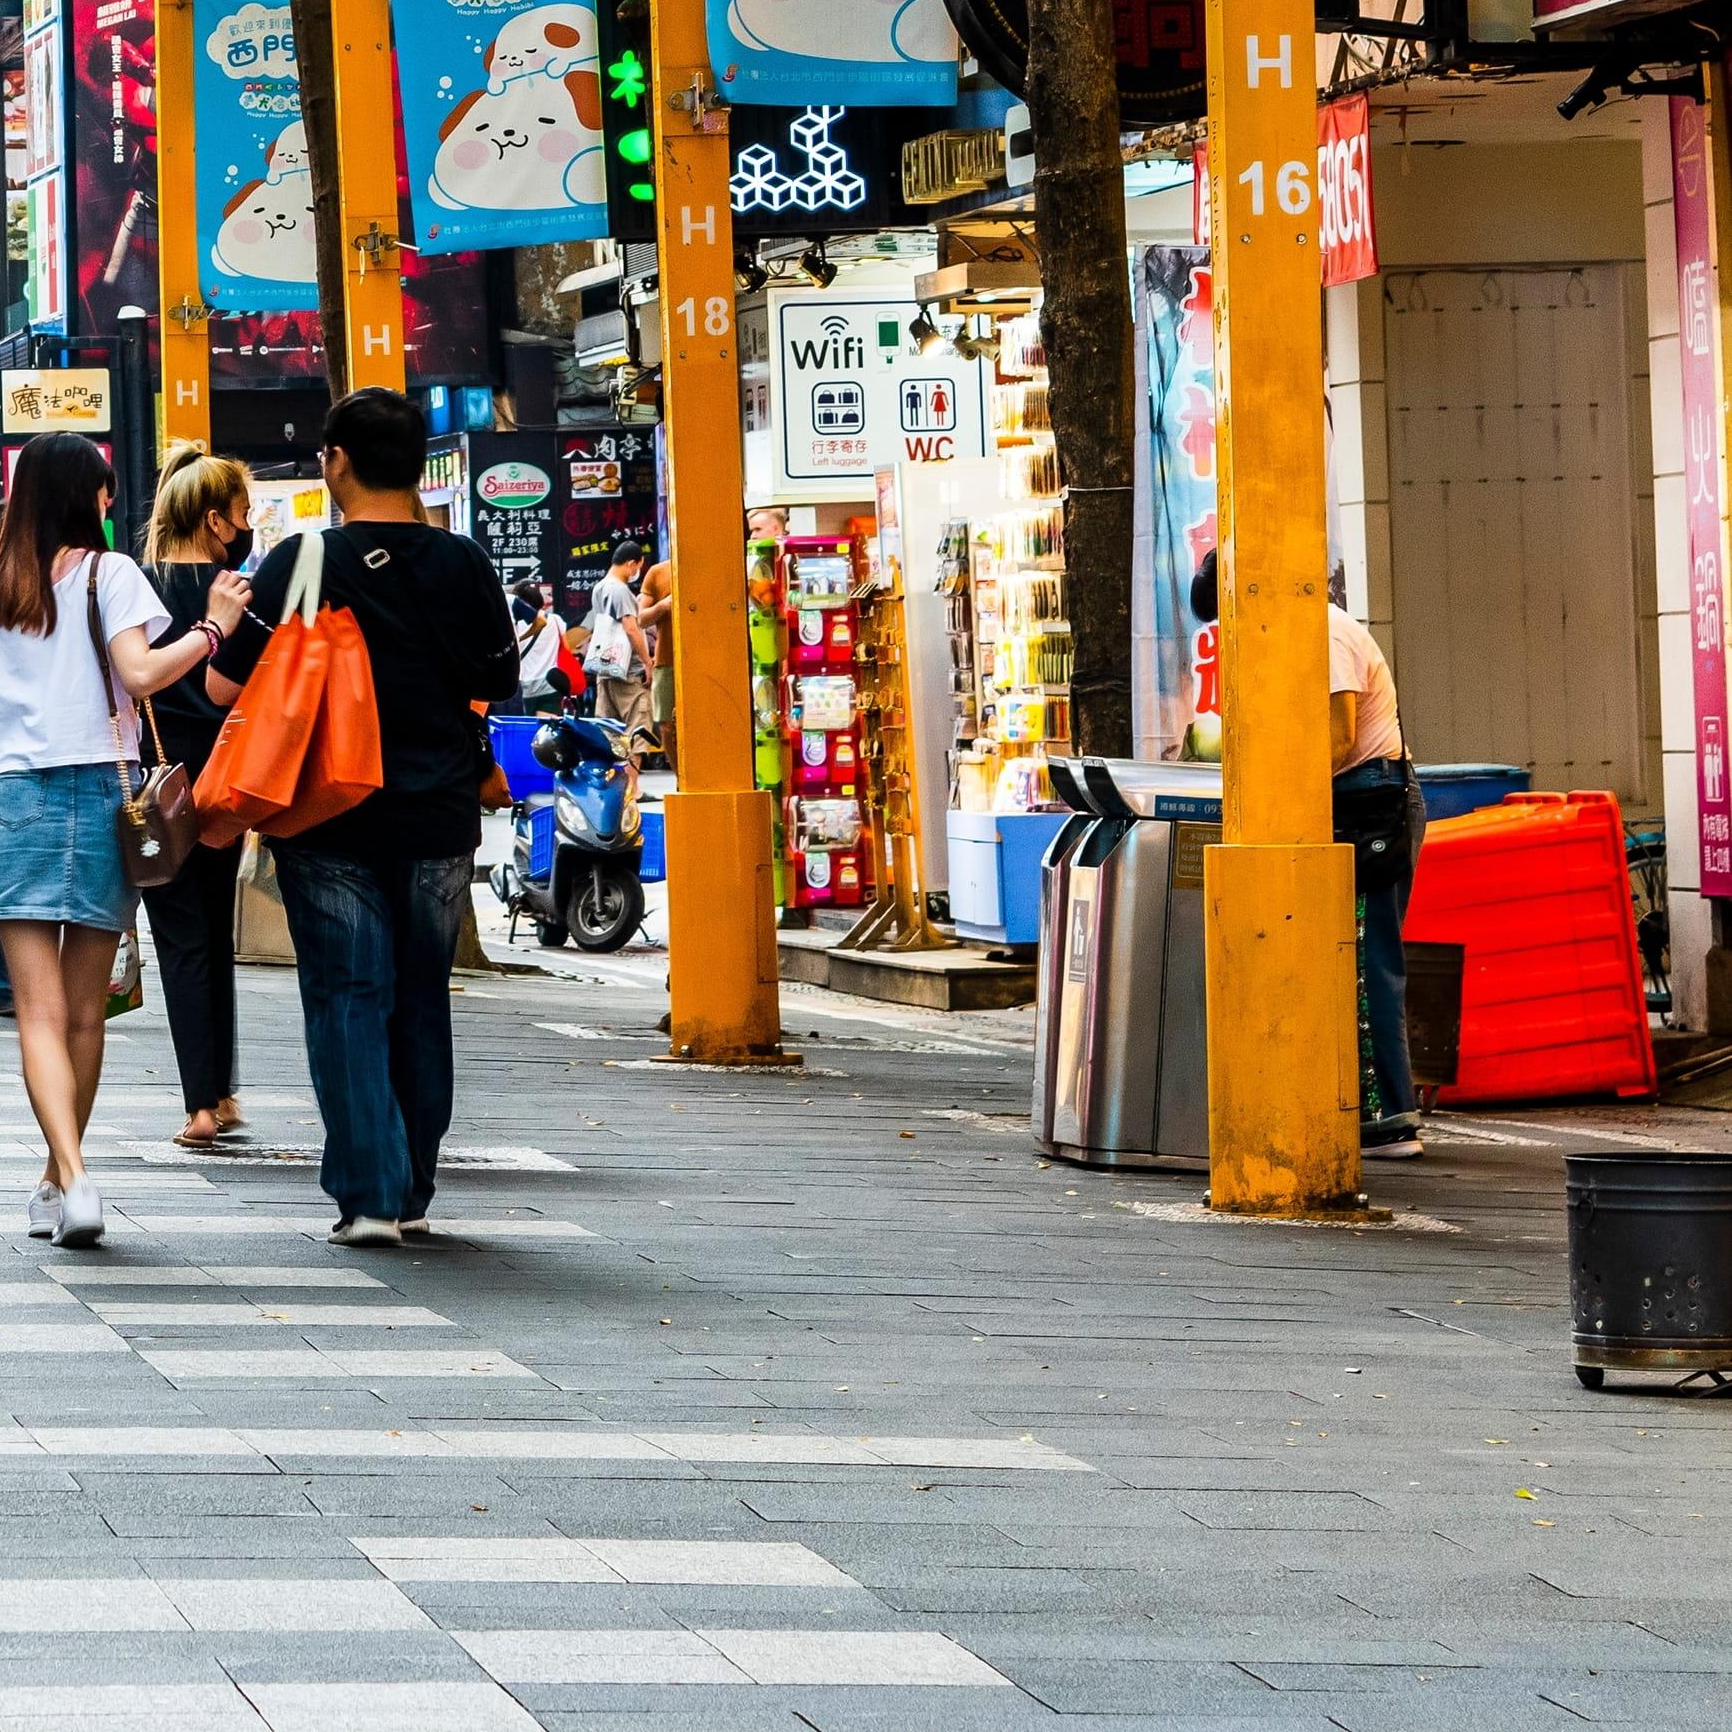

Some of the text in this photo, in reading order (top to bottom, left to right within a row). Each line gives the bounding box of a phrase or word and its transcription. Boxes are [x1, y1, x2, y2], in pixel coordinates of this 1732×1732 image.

[227, 34, 297, 68] 西門
[1245, 35, 1292, 88] H
[1238, 161, 1310, 217] 16
[681, 206, 715, 246] H
[675, 296, 729, 336] 18
[363, 325, 390, 356] H
[791, 337, 864, 370] Wifi
[176, 380, 199, 407] H
[812, 439, 868, 454] 行李寄存
[905, 435, 955, 461] WC
[483, 475, 546, 494] Saizeriya
